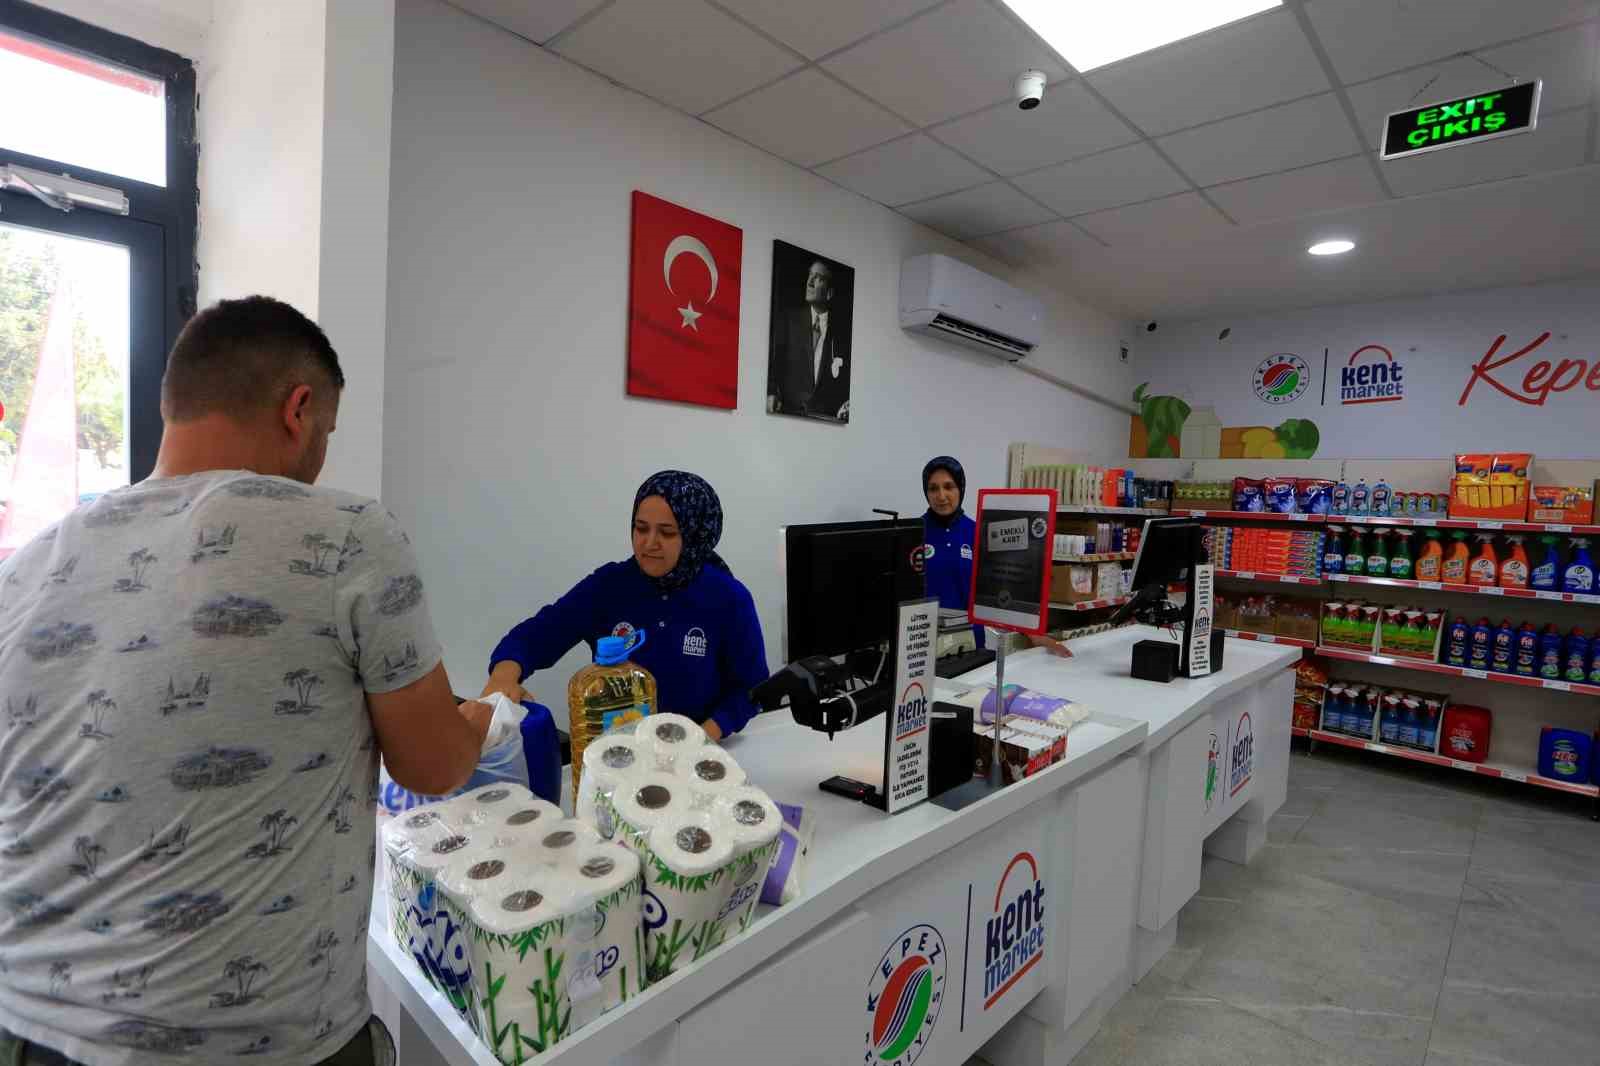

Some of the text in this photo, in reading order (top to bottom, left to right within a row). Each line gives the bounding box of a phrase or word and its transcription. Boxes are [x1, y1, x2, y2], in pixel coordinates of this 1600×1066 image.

[1416, 93, 1502, 126] EXIT
[1341, 361, 1403, 387] kent
[1341, 382, 1403, 400] market
[684, 634, 707, 648] kent
[897, 698, 928, 724] kent
[985, 879, 1045, 969] kent
[983, 921, 1044, 999] market
